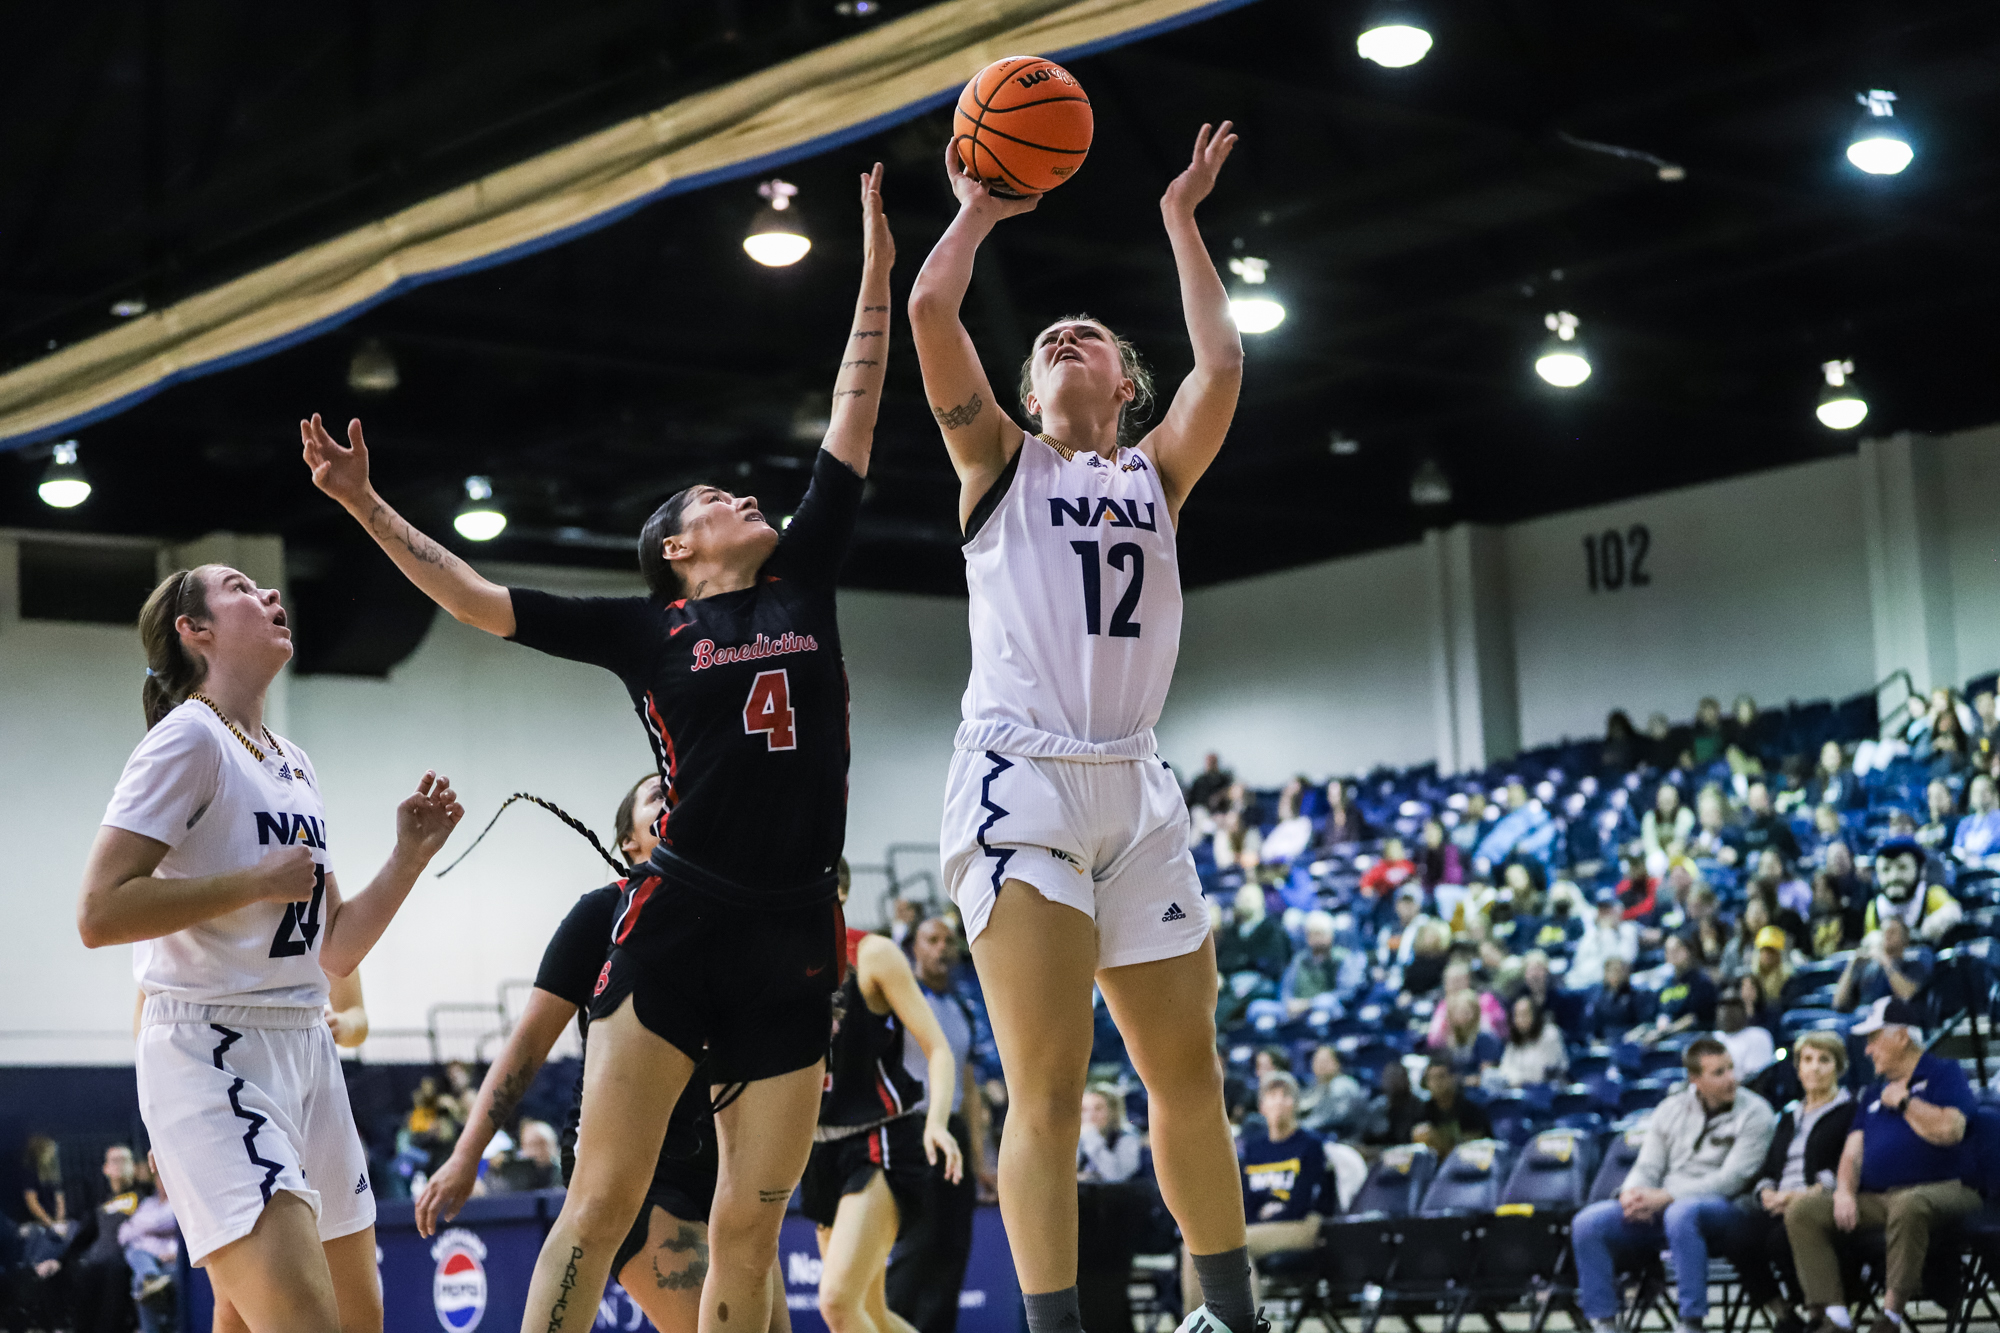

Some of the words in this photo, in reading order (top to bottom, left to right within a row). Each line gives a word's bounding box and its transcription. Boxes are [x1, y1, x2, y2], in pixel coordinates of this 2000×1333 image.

[1047, 496, 1157, 533] NAU
[1582, 522, 1651, 594] 102
[1069, 540, 1145, 639] 12
[690, 630, 819, 672] Benedictine
[742, 668, 797, 752] 4
[1161, 912, 1187, 923] adidas
